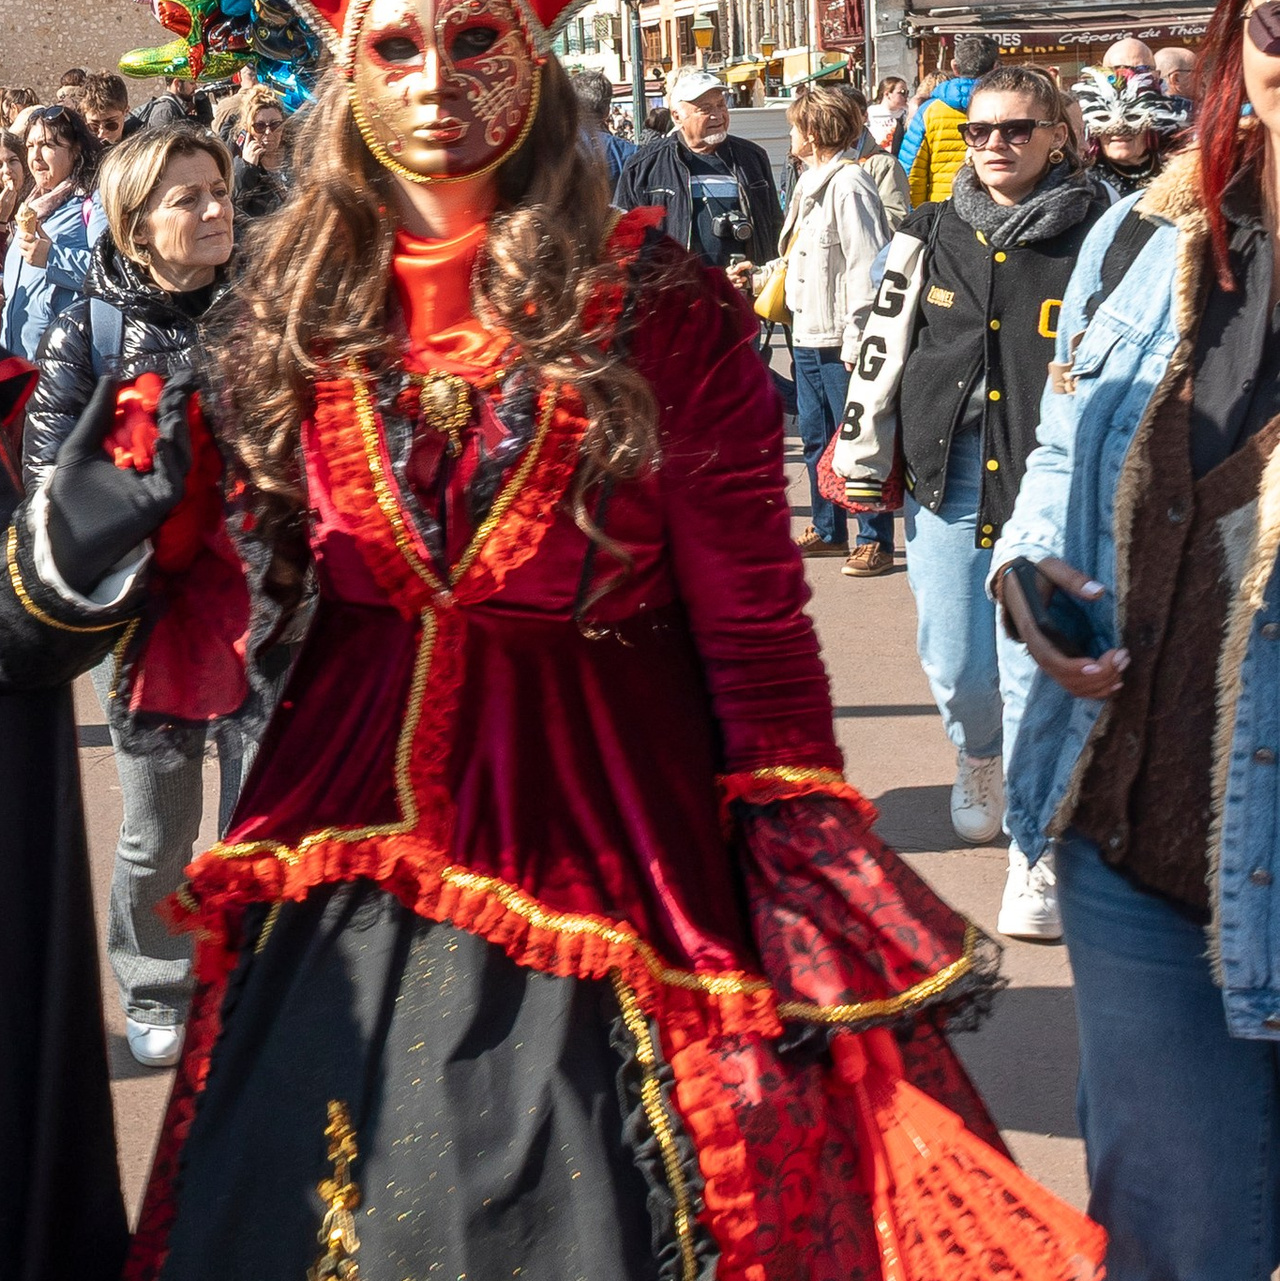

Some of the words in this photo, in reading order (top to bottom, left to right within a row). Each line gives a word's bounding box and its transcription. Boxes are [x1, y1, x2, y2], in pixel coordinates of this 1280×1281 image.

[1138, 29, 1161, 39] du
[873, 269, 908, 318] G
[858, 335, 888, 382] G
[840, 401, 865, 441] B
